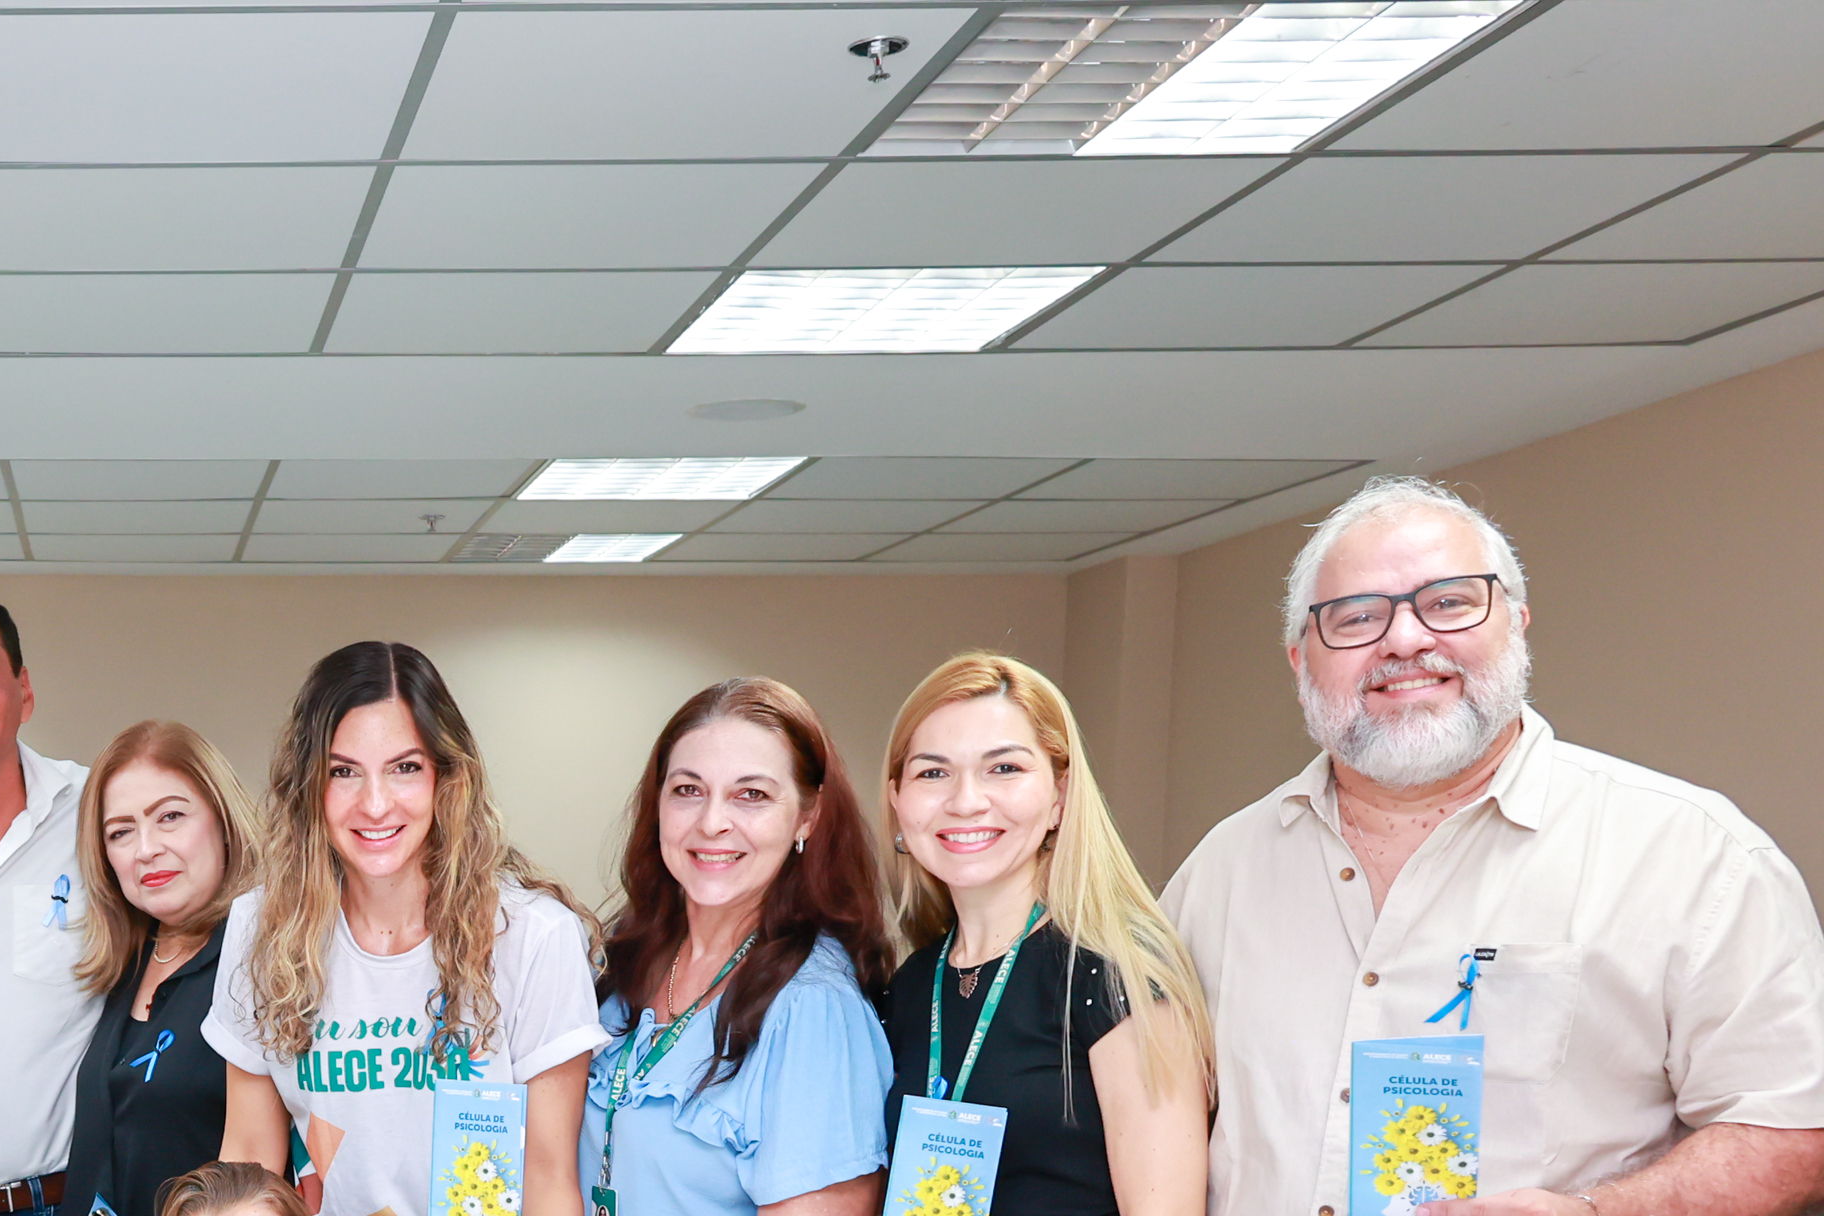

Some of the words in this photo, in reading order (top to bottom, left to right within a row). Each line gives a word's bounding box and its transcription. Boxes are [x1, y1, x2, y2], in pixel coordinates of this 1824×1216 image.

[348, 1016, 423, 1040] sou
[964, 1030, 983, 1066] ALECE
[296, 1048, 384, 1092] ALECE
[610, 1068, 626, 1100] ALECE
[1389, 1075, 1438, 1085] CÉLULA
[1383, 1086, 1463, 1096] PSICOLOGIA
[458, 1111, 491, 1122] CÉLULA
[494, 1115, 505, 1123] DE
[454, 1123, 508, 1133] PSICOLOGIA
[928, 1132, 966, 1146] CÉLULA
[969, 1138, 983, 1148] DE
[922, 1143, 985, 1159] PSICOLOGIA
